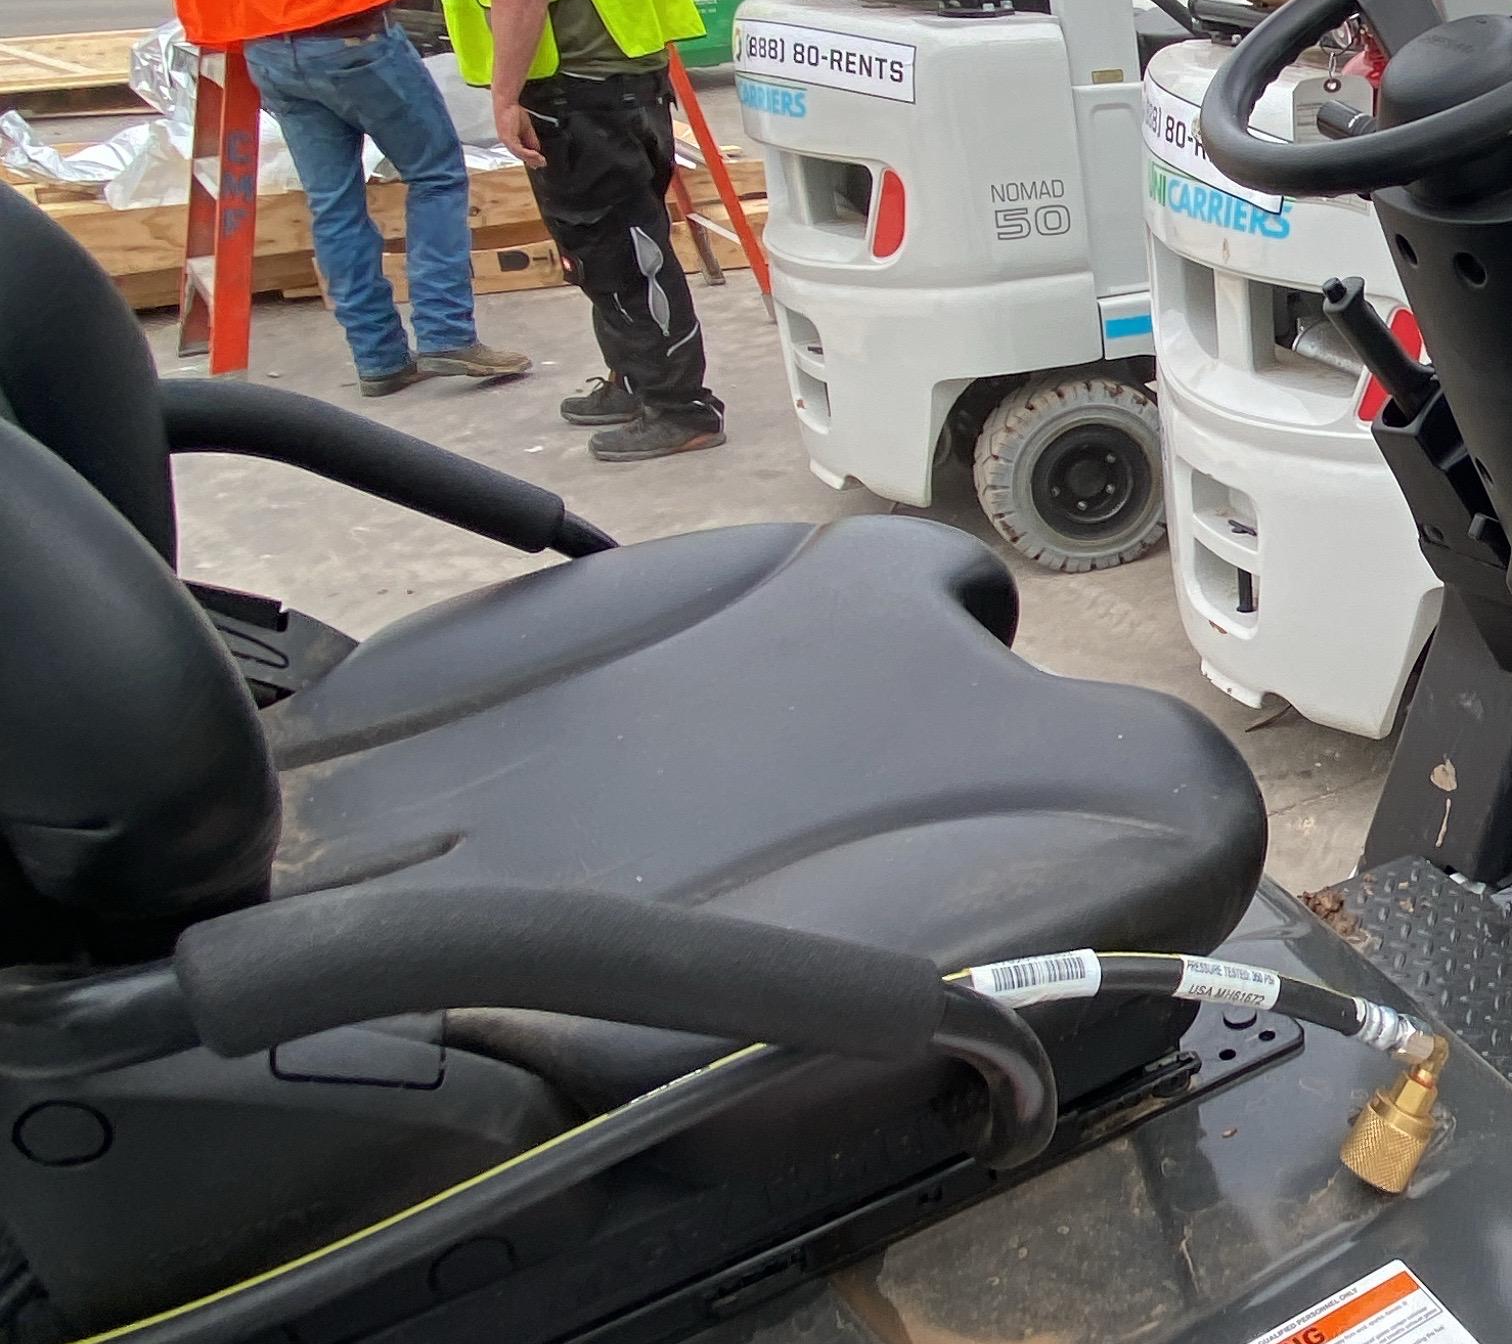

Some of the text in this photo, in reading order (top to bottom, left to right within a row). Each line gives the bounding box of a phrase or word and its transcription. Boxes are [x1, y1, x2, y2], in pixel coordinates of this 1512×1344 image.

[793, 42, 904, 83] 80-RENTS
[990, 179, 1066, 203] NOMAD
[994, 204, 1072, 241] 50
[1188, 984, 1212, 997] USA
